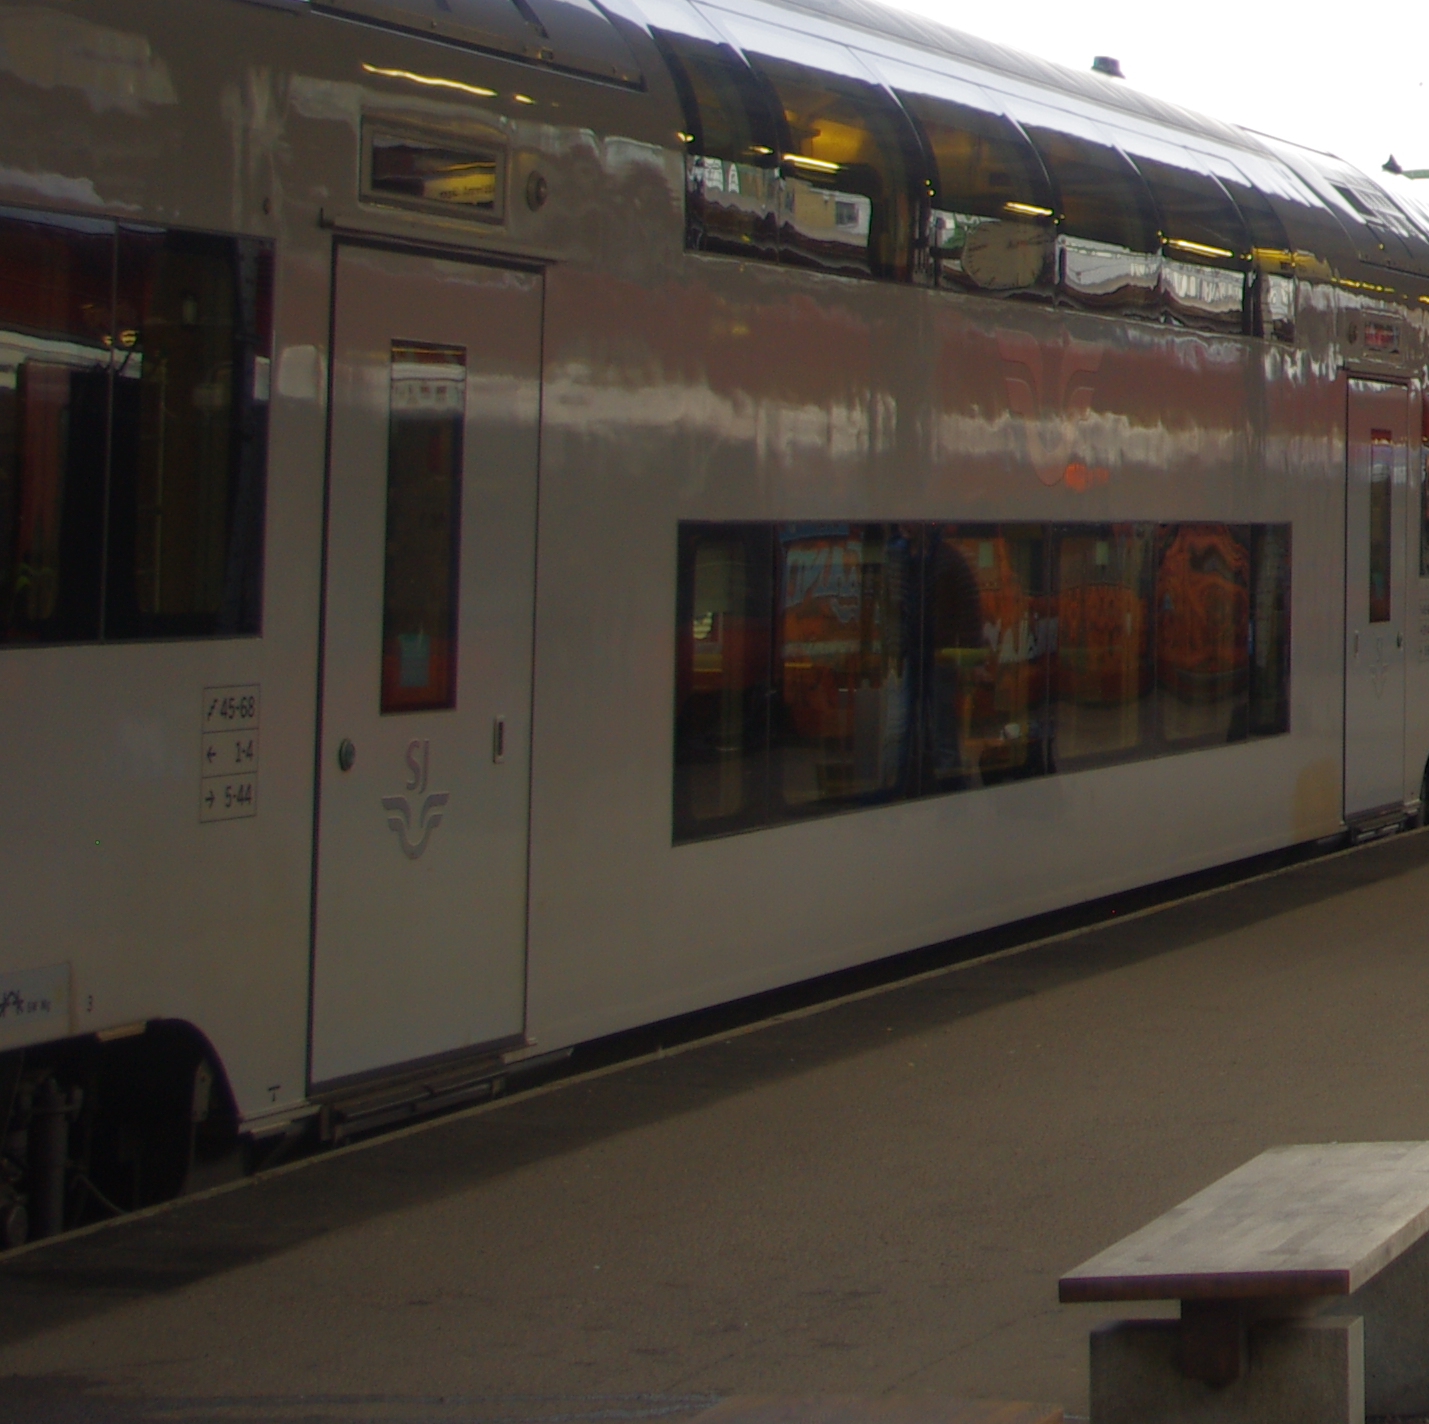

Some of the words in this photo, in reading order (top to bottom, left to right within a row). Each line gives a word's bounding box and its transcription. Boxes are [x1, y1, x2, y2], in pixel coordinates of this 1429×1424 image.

[220, 696, 255, 719] 45-68
[235, 740, 254, 763] 1-4
[405, 738, 430, 794] SJ
[224, 783, 252, 808] 5-44
